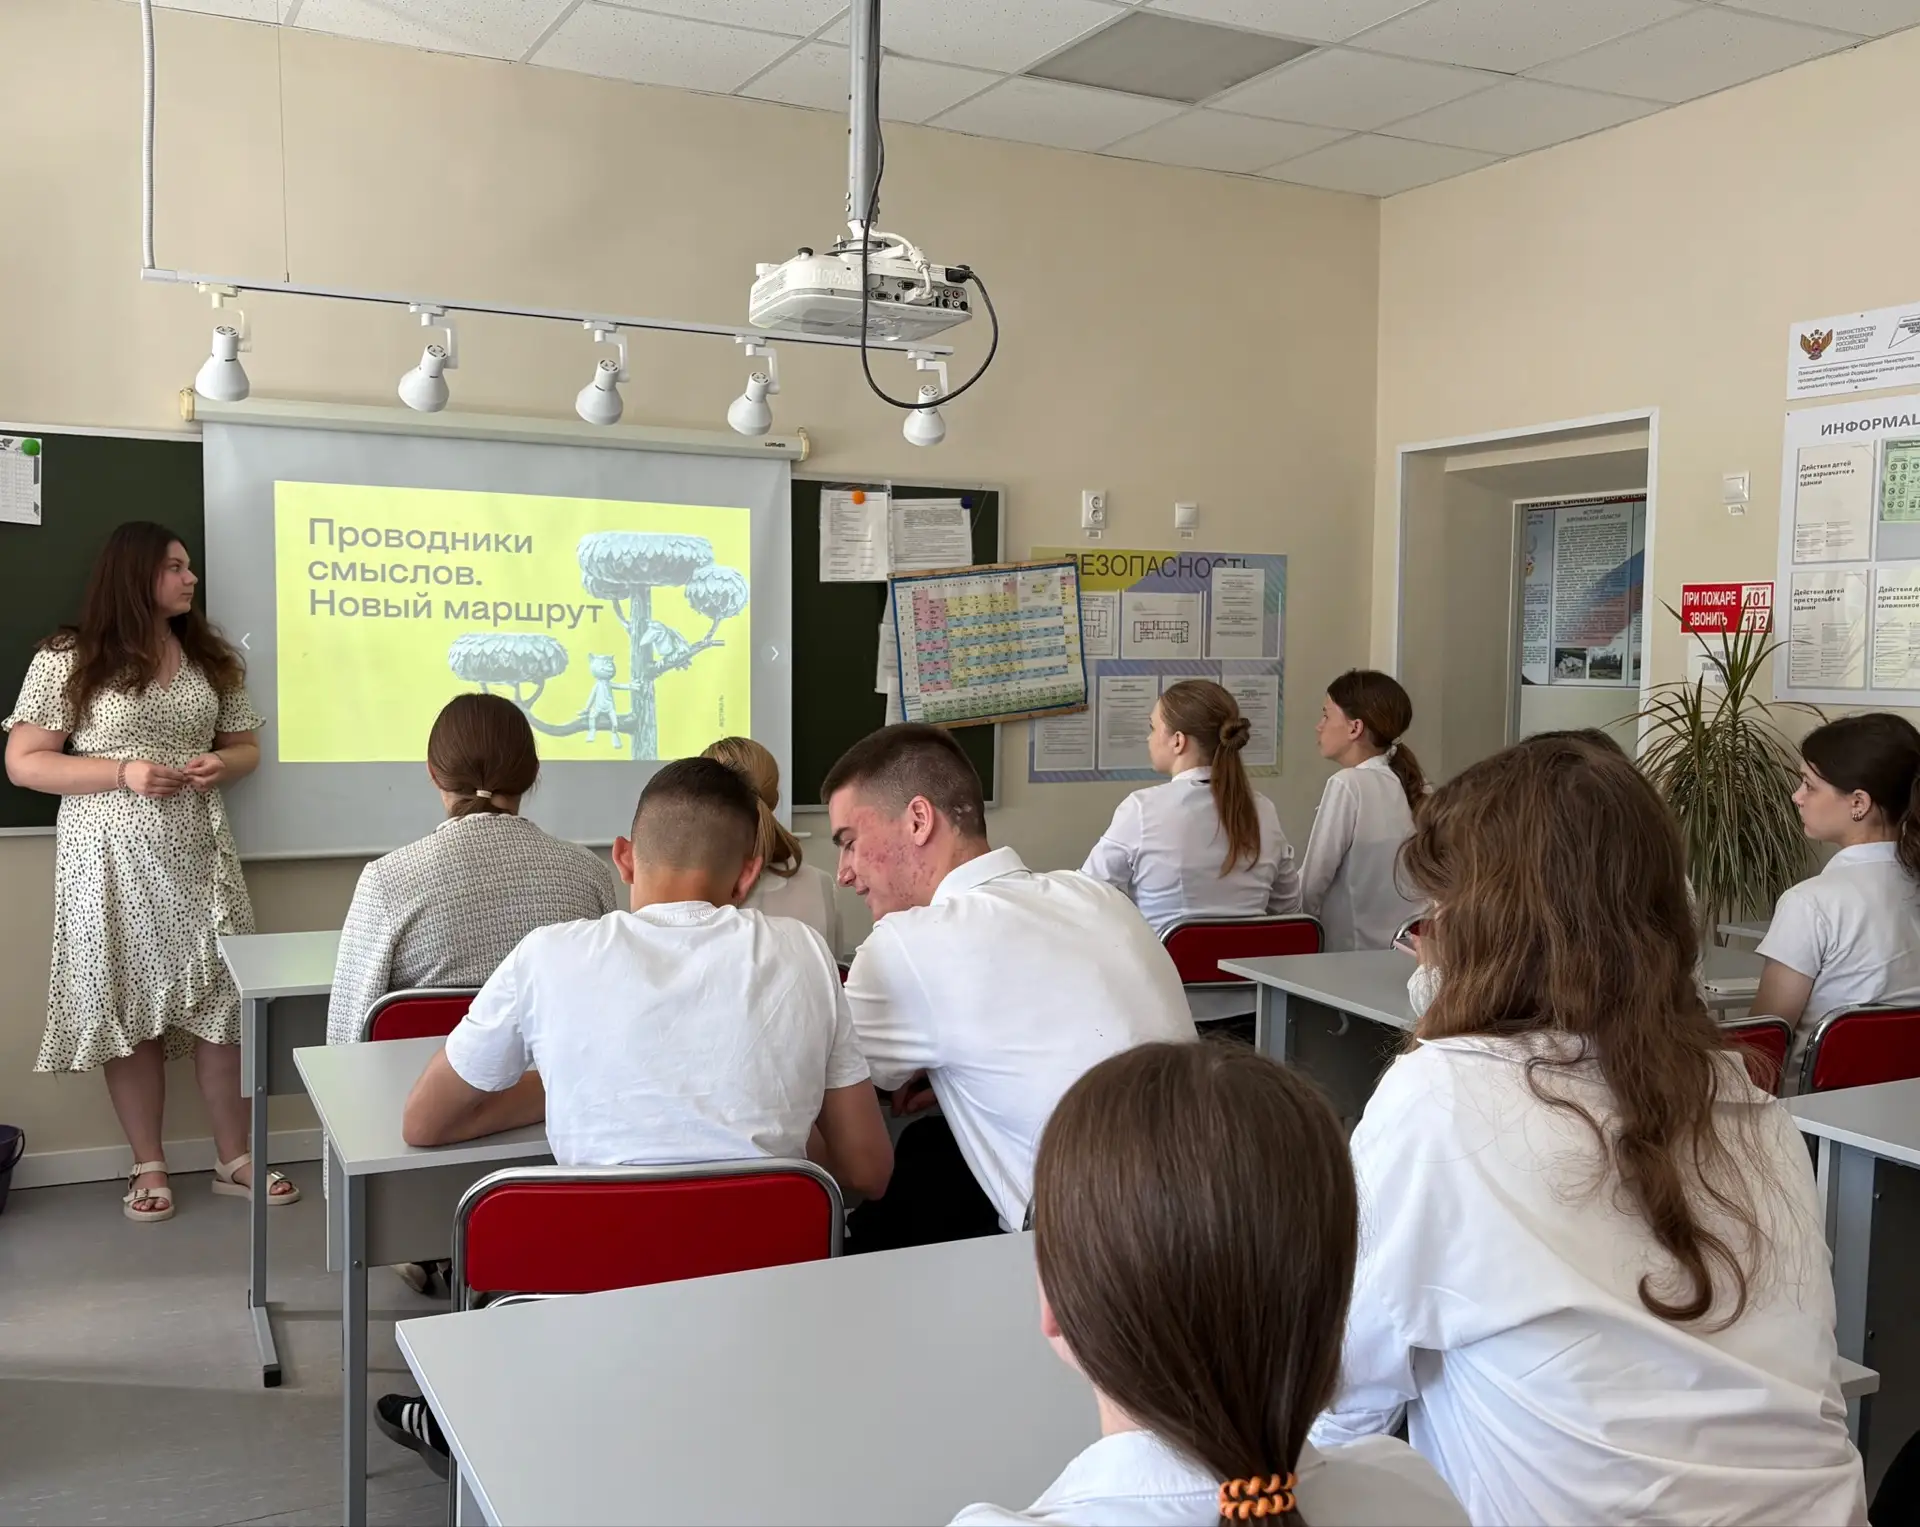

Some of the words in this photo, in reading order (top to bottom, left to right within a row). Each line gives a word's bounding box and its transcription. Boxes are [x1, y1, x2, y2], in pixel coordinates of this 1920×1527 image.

[309, 517, 533, 554] Проводники
[308, 560, 483, 586] смыслов.
[1065, 553, 1251, 579] ЕЗОПАСНО
[310, 589, 432, 619] Новый
[444, 600, 604, 629] маршрут
[1683, 591, 1700, 606] ПРИ
[1701, 591, 1737, 606] ПОЖАРЕ
[1746, 591, 1766, 606] 101
[1689, 611, 1728, 626] ЗВОНИТЬ
